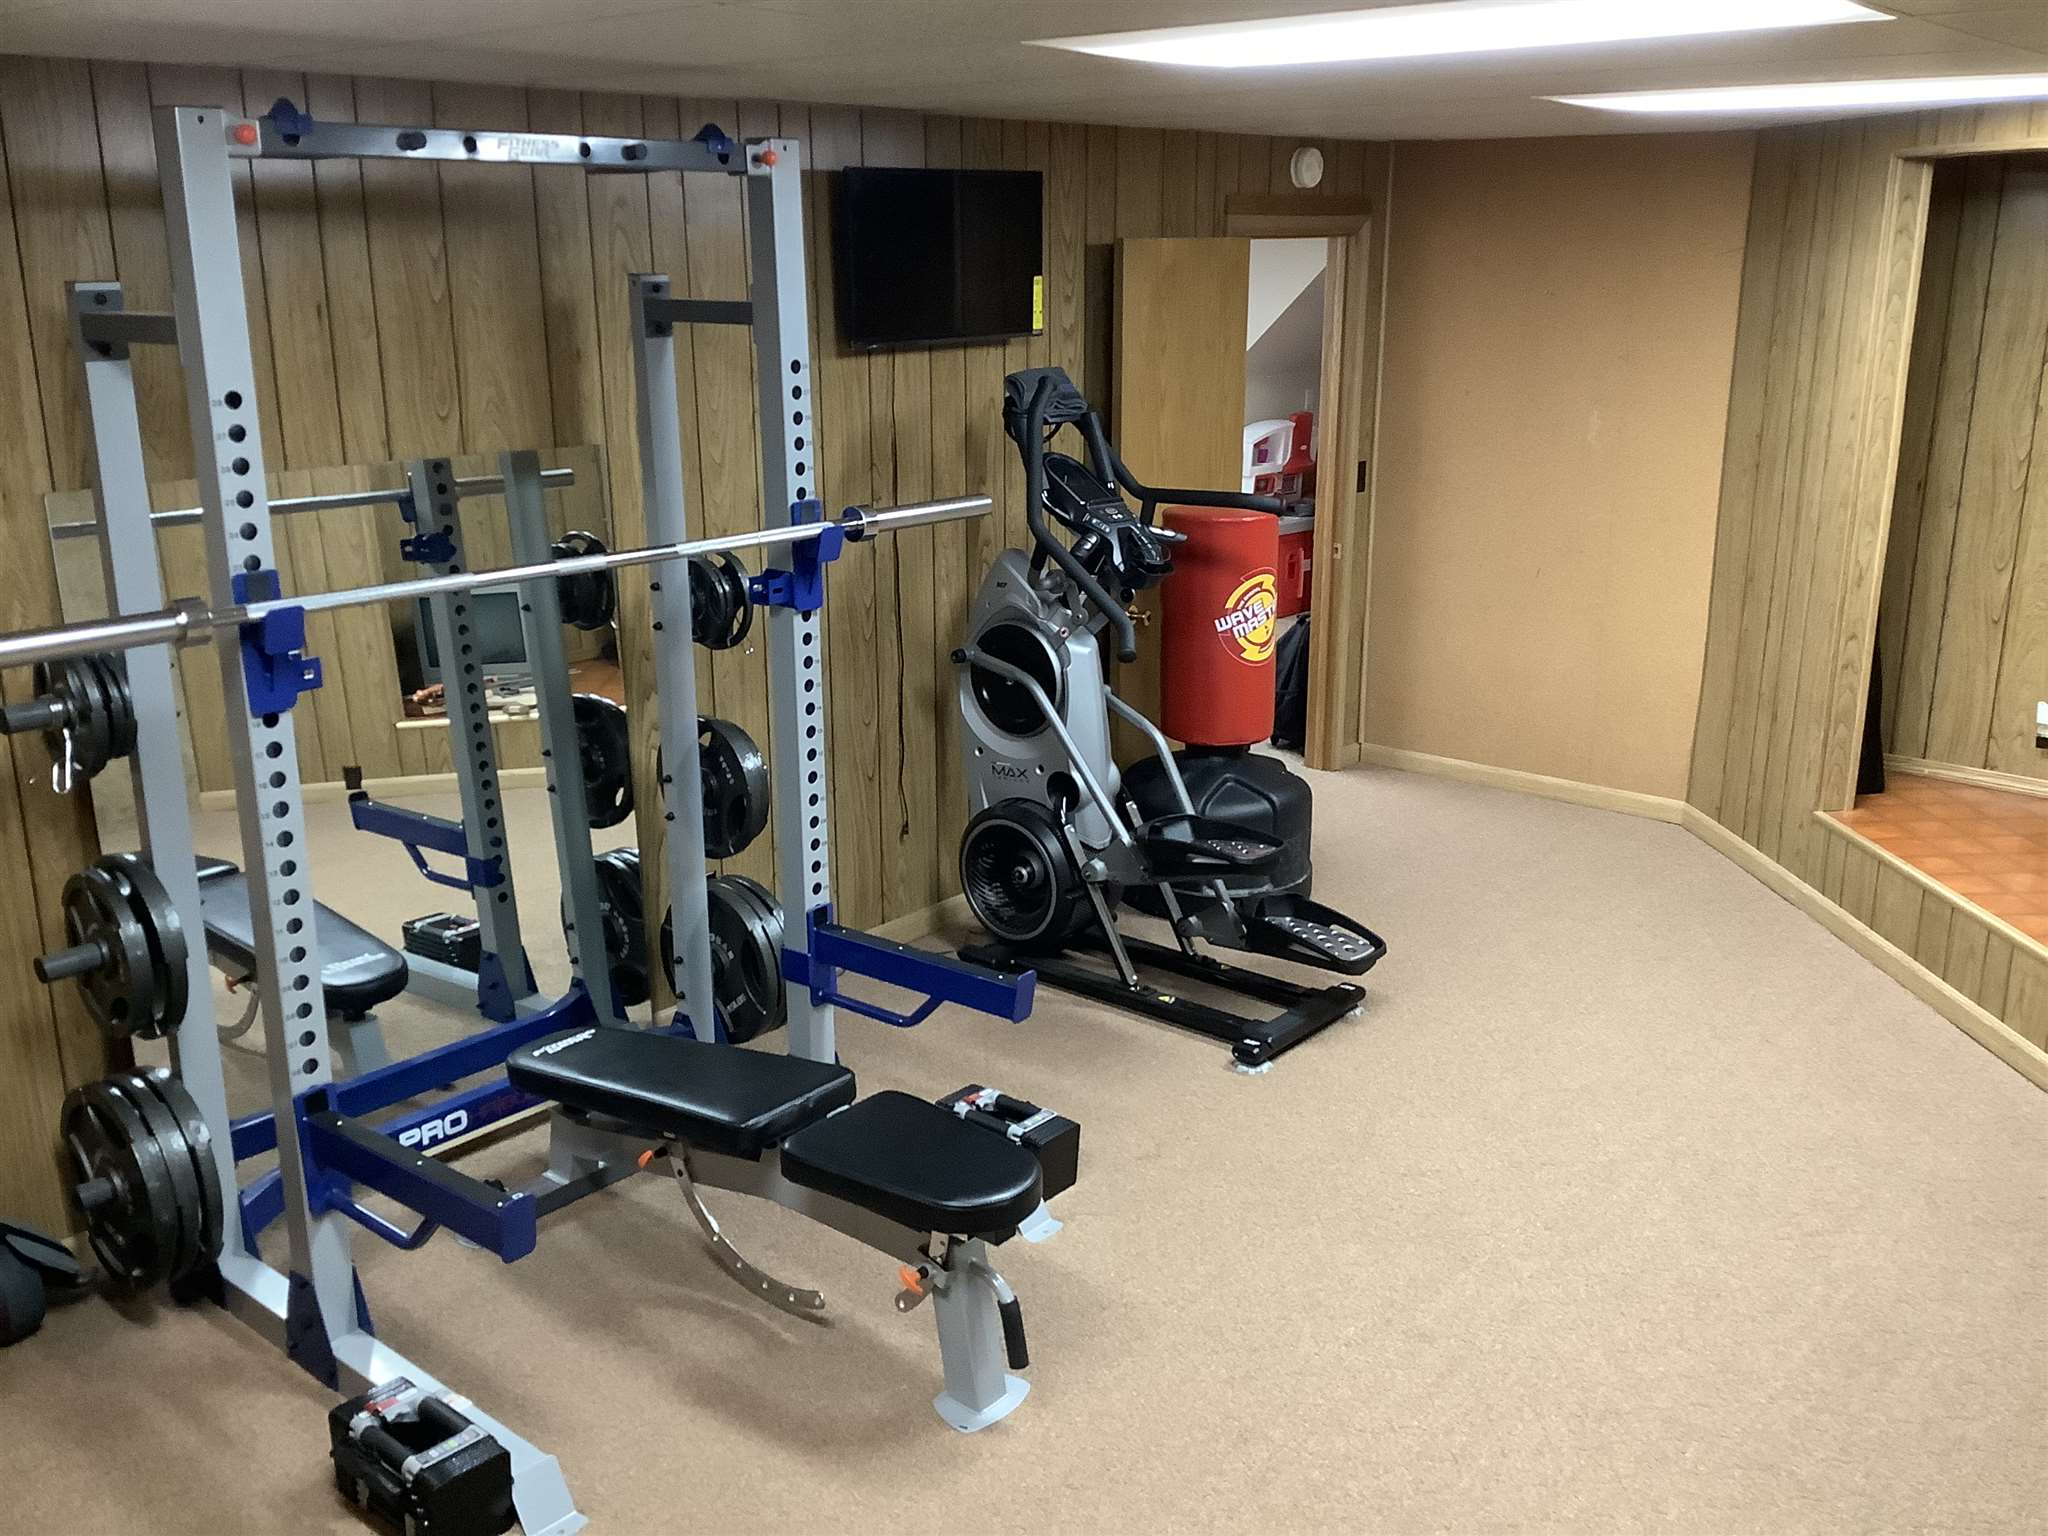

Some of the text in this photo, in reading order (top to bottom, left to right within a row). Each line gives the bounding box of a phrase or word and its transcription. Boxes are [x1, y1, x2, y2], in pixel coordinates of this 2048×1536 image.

[1214, 599, 1264, 632] WAVE
[1232, 605, 1275, 639] MAST
[992, 764, 1028, 779] MAX
[399, 1109, 468, 1147] PRO
